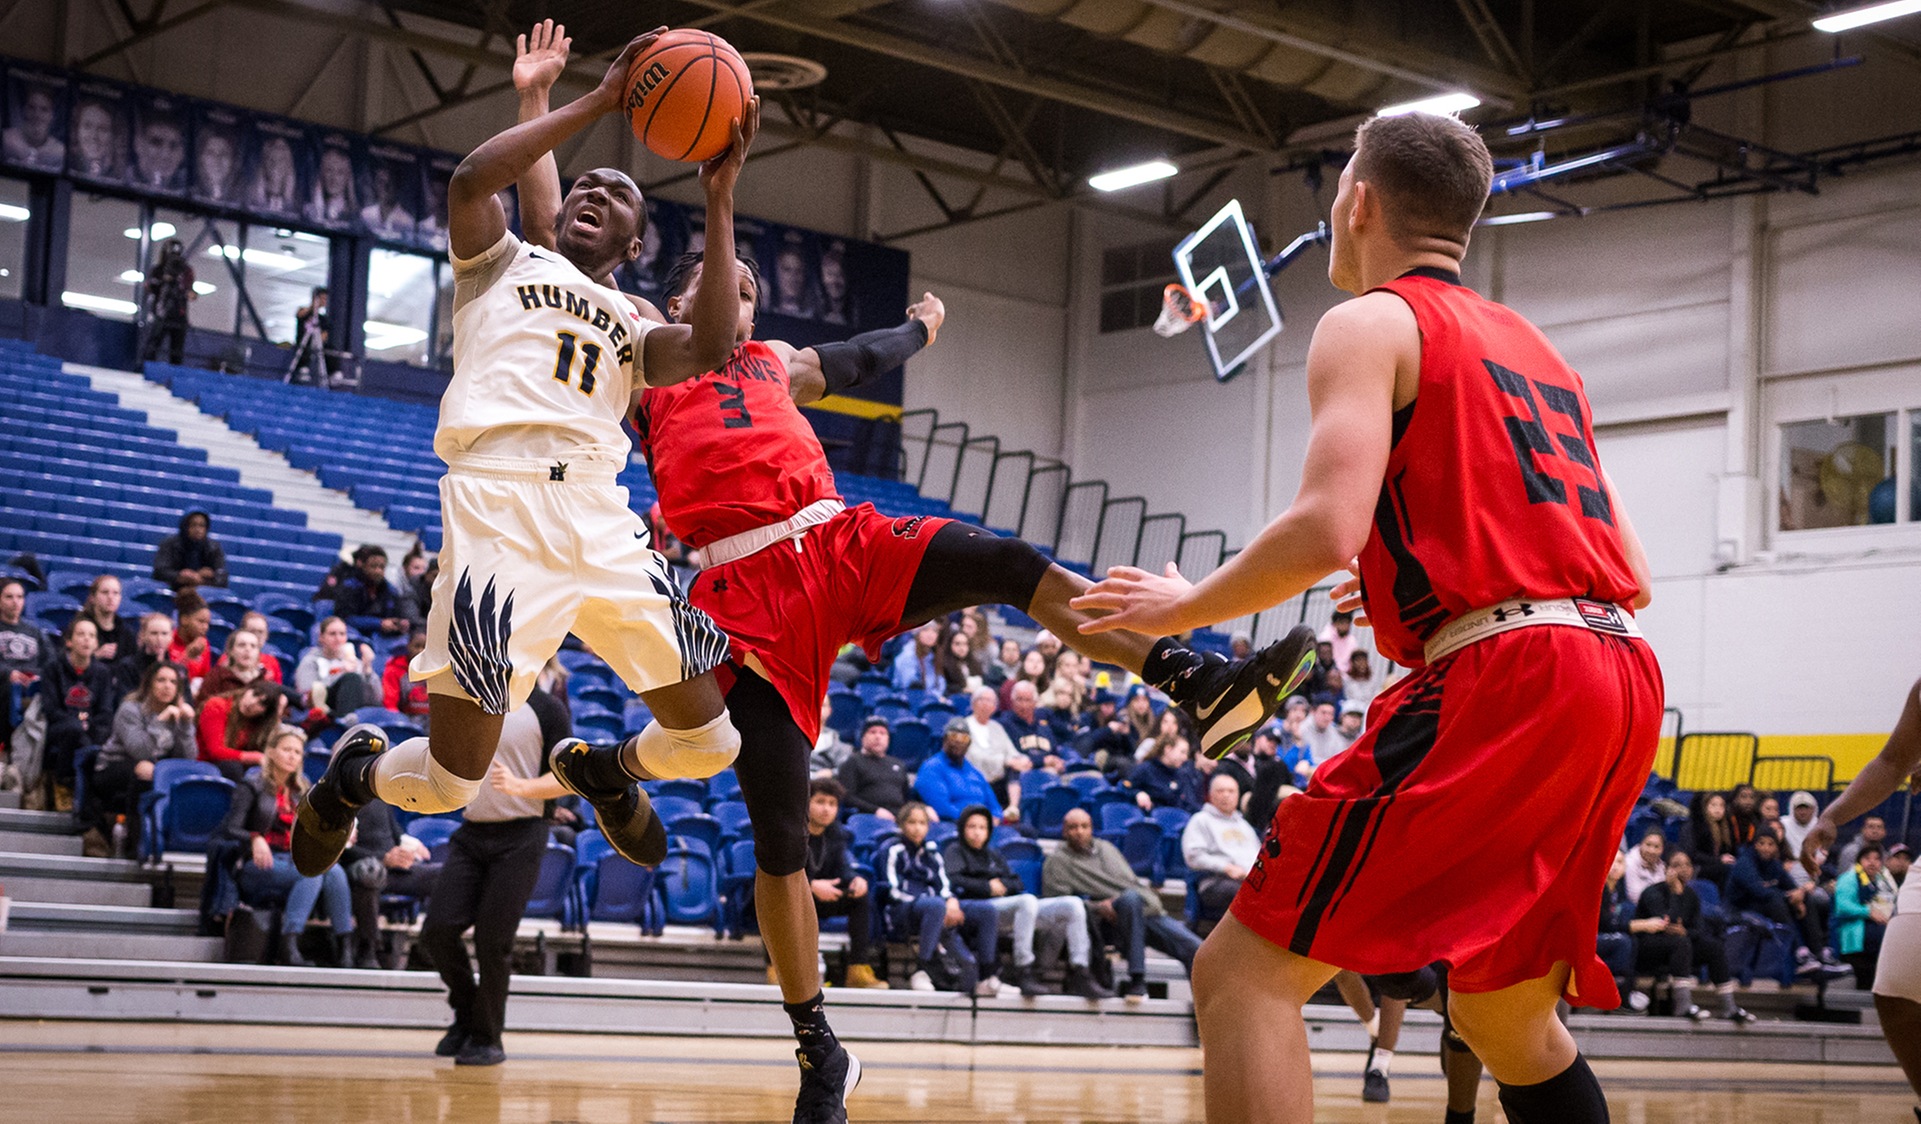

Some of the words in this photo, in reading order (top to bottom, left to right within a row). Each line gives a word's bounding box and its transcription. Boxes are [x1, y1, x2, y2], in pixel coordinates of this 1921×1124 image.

[625, 61, 671, 122] Wilso
[516, 284, 633, 367] HUMBER
[551, 329, 604, 399] 11
[712, 381, 753, 429] 3
[1480, 357, 1617, 529] 23
